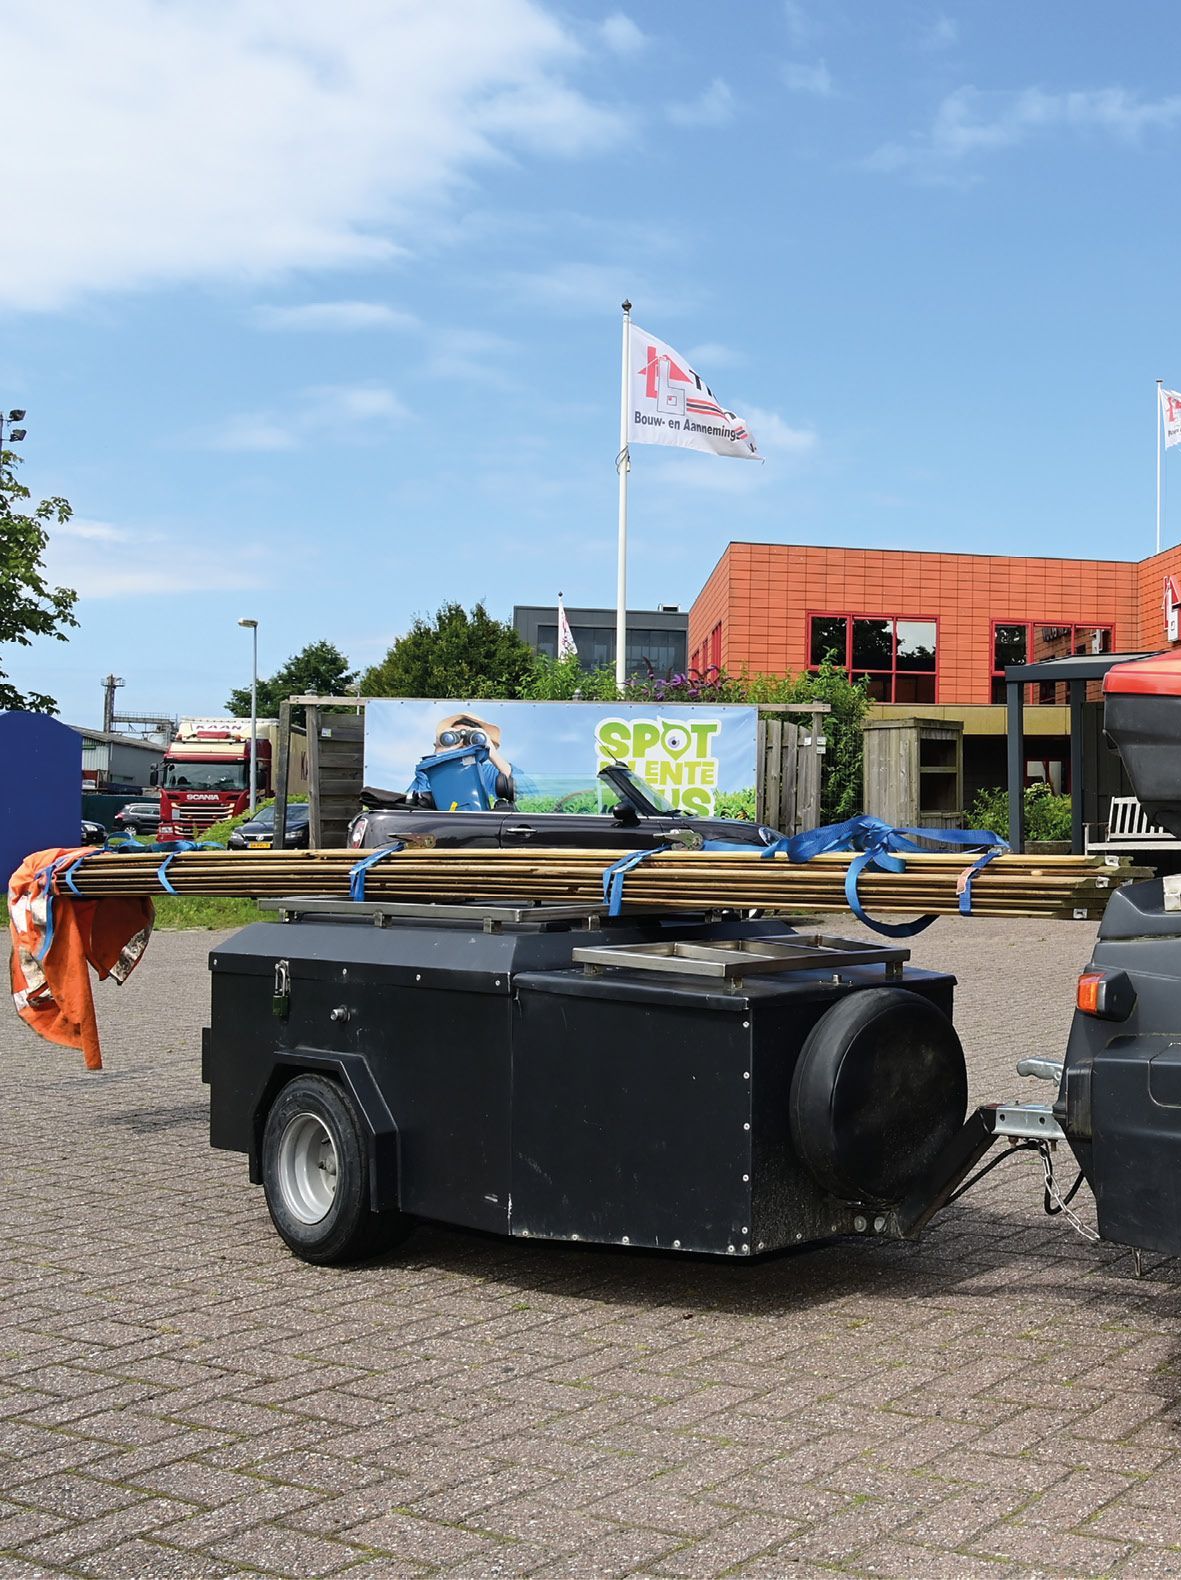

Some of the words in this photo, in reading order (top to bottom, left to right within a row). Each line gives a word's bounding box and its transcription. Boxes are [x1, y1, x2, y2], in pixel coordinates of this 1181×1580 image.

[634, 411, 666, 426] Bouw-
[668, 419, 680, 430] en
[599, 720, 718, 760] SPOT
